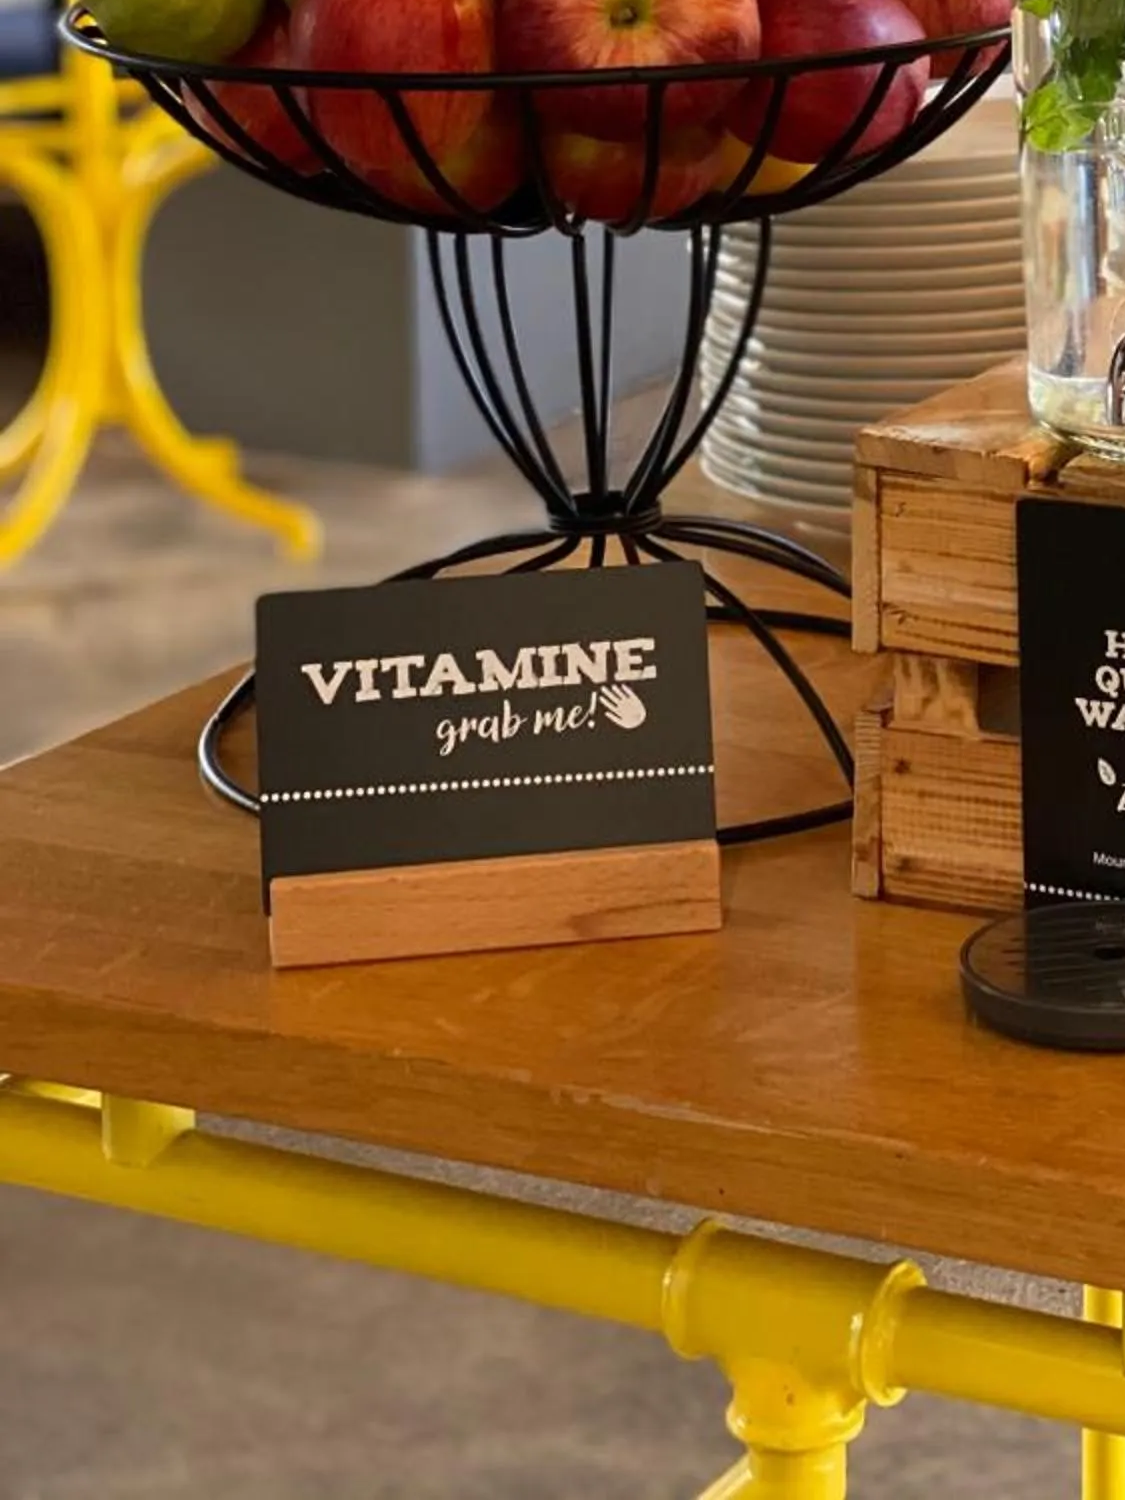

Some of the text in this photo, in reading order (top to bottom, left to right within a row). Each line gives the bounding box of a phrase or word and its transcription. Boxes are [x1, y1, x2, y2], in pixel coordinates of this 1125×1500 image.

[301, 637, 657, 705] VITAMINE
[436, 692, 598, 756] grab me!
